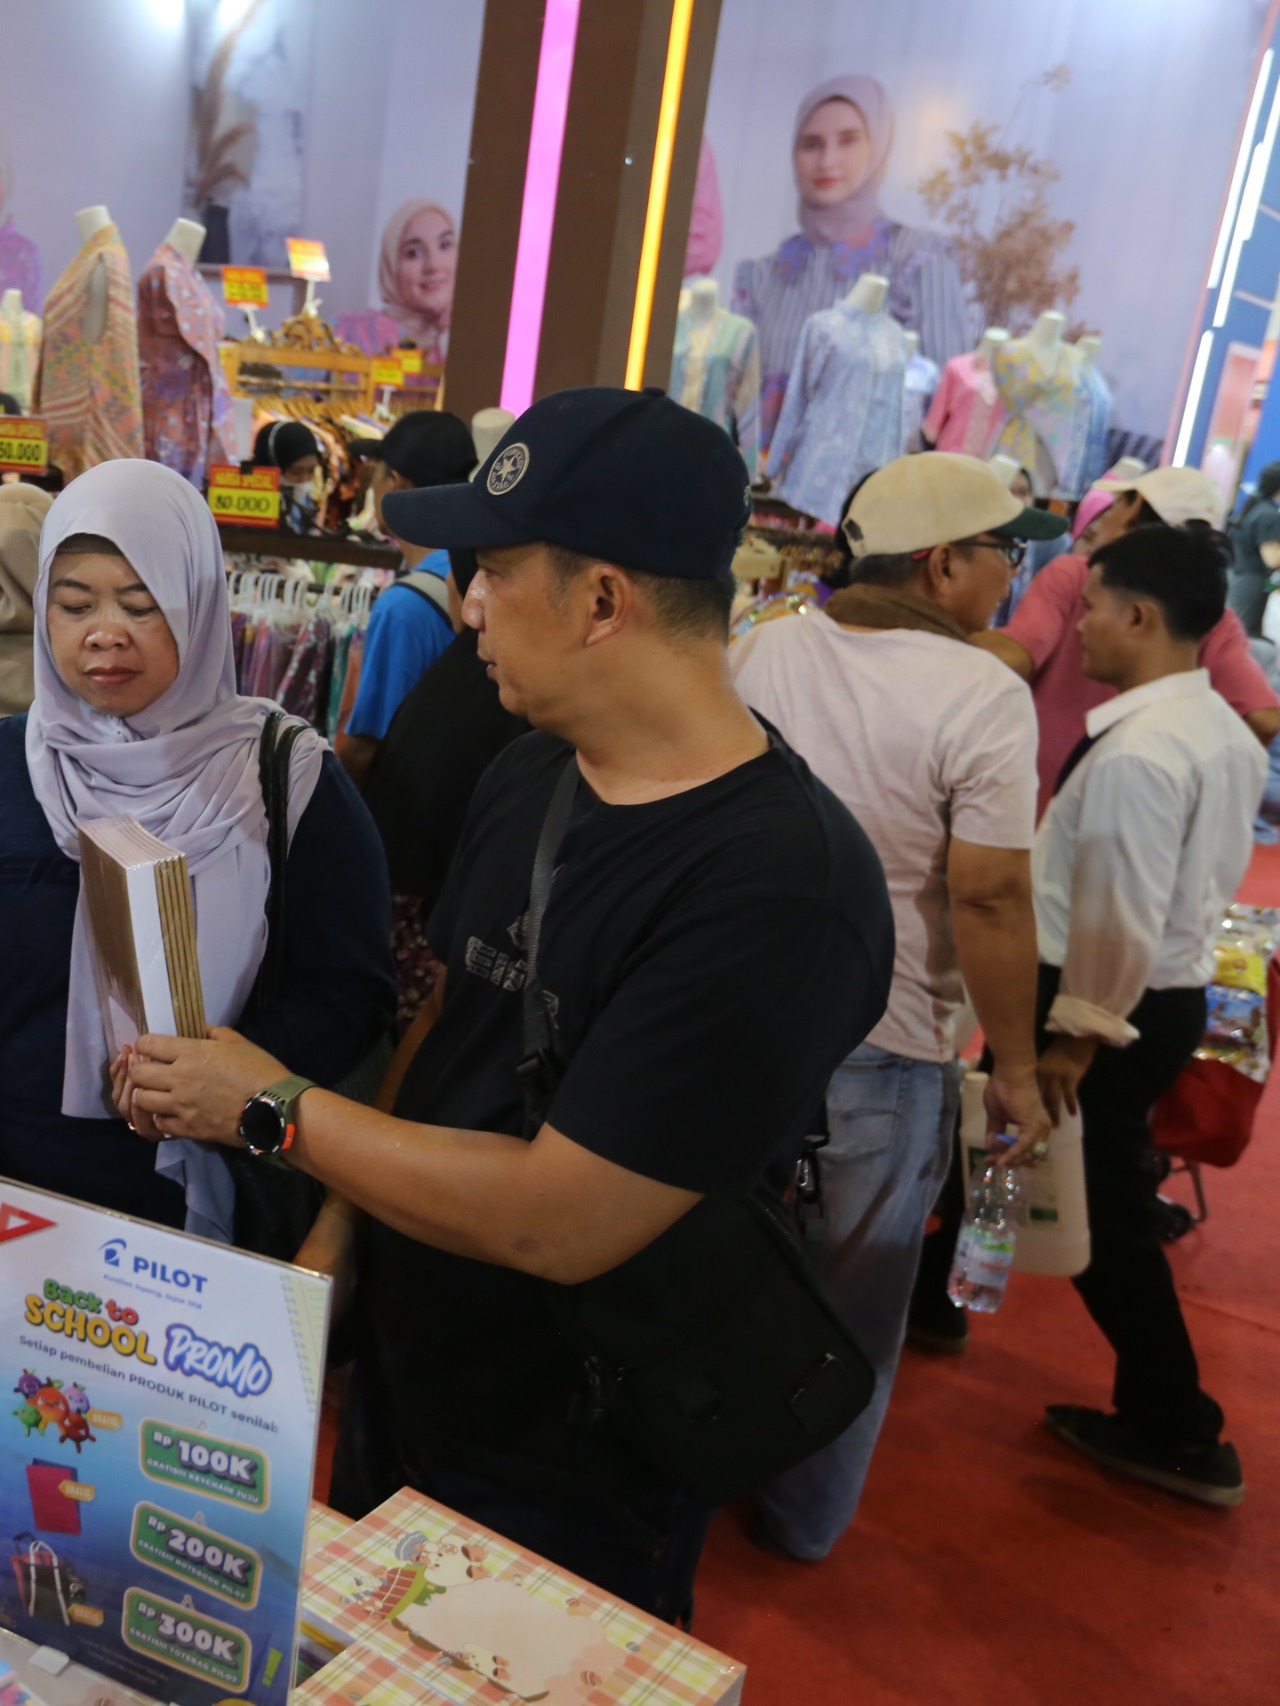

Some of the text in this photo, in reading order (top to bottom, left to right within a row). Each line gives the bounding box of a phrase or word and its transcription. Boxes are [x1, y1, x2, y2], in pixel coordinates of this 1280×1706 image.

[133, 1256, 208, 1293] PILOT
[105, 1299, 139, 1326] to
[24, 1294, 273, 1398] SCHOOL PROMO
[19, 1335, 280, 1434] Setiap pembelian PRODUK PILOT senilai:
[177, 1439, 255, 1484] 100K
[188, 1472, 235, 1496] KEYCHAIN
[168, 1528, 248, 1582] 200K
[174, 1556, 221, 1587] NOTEBOOK
[221, 1583, 247, 1600] PILOT
[157, 1612, 237, 1664] 300K
[170, 1645, 210, 1671] TOTEBAG
[211, 1666, 239, 1685] PILOT
